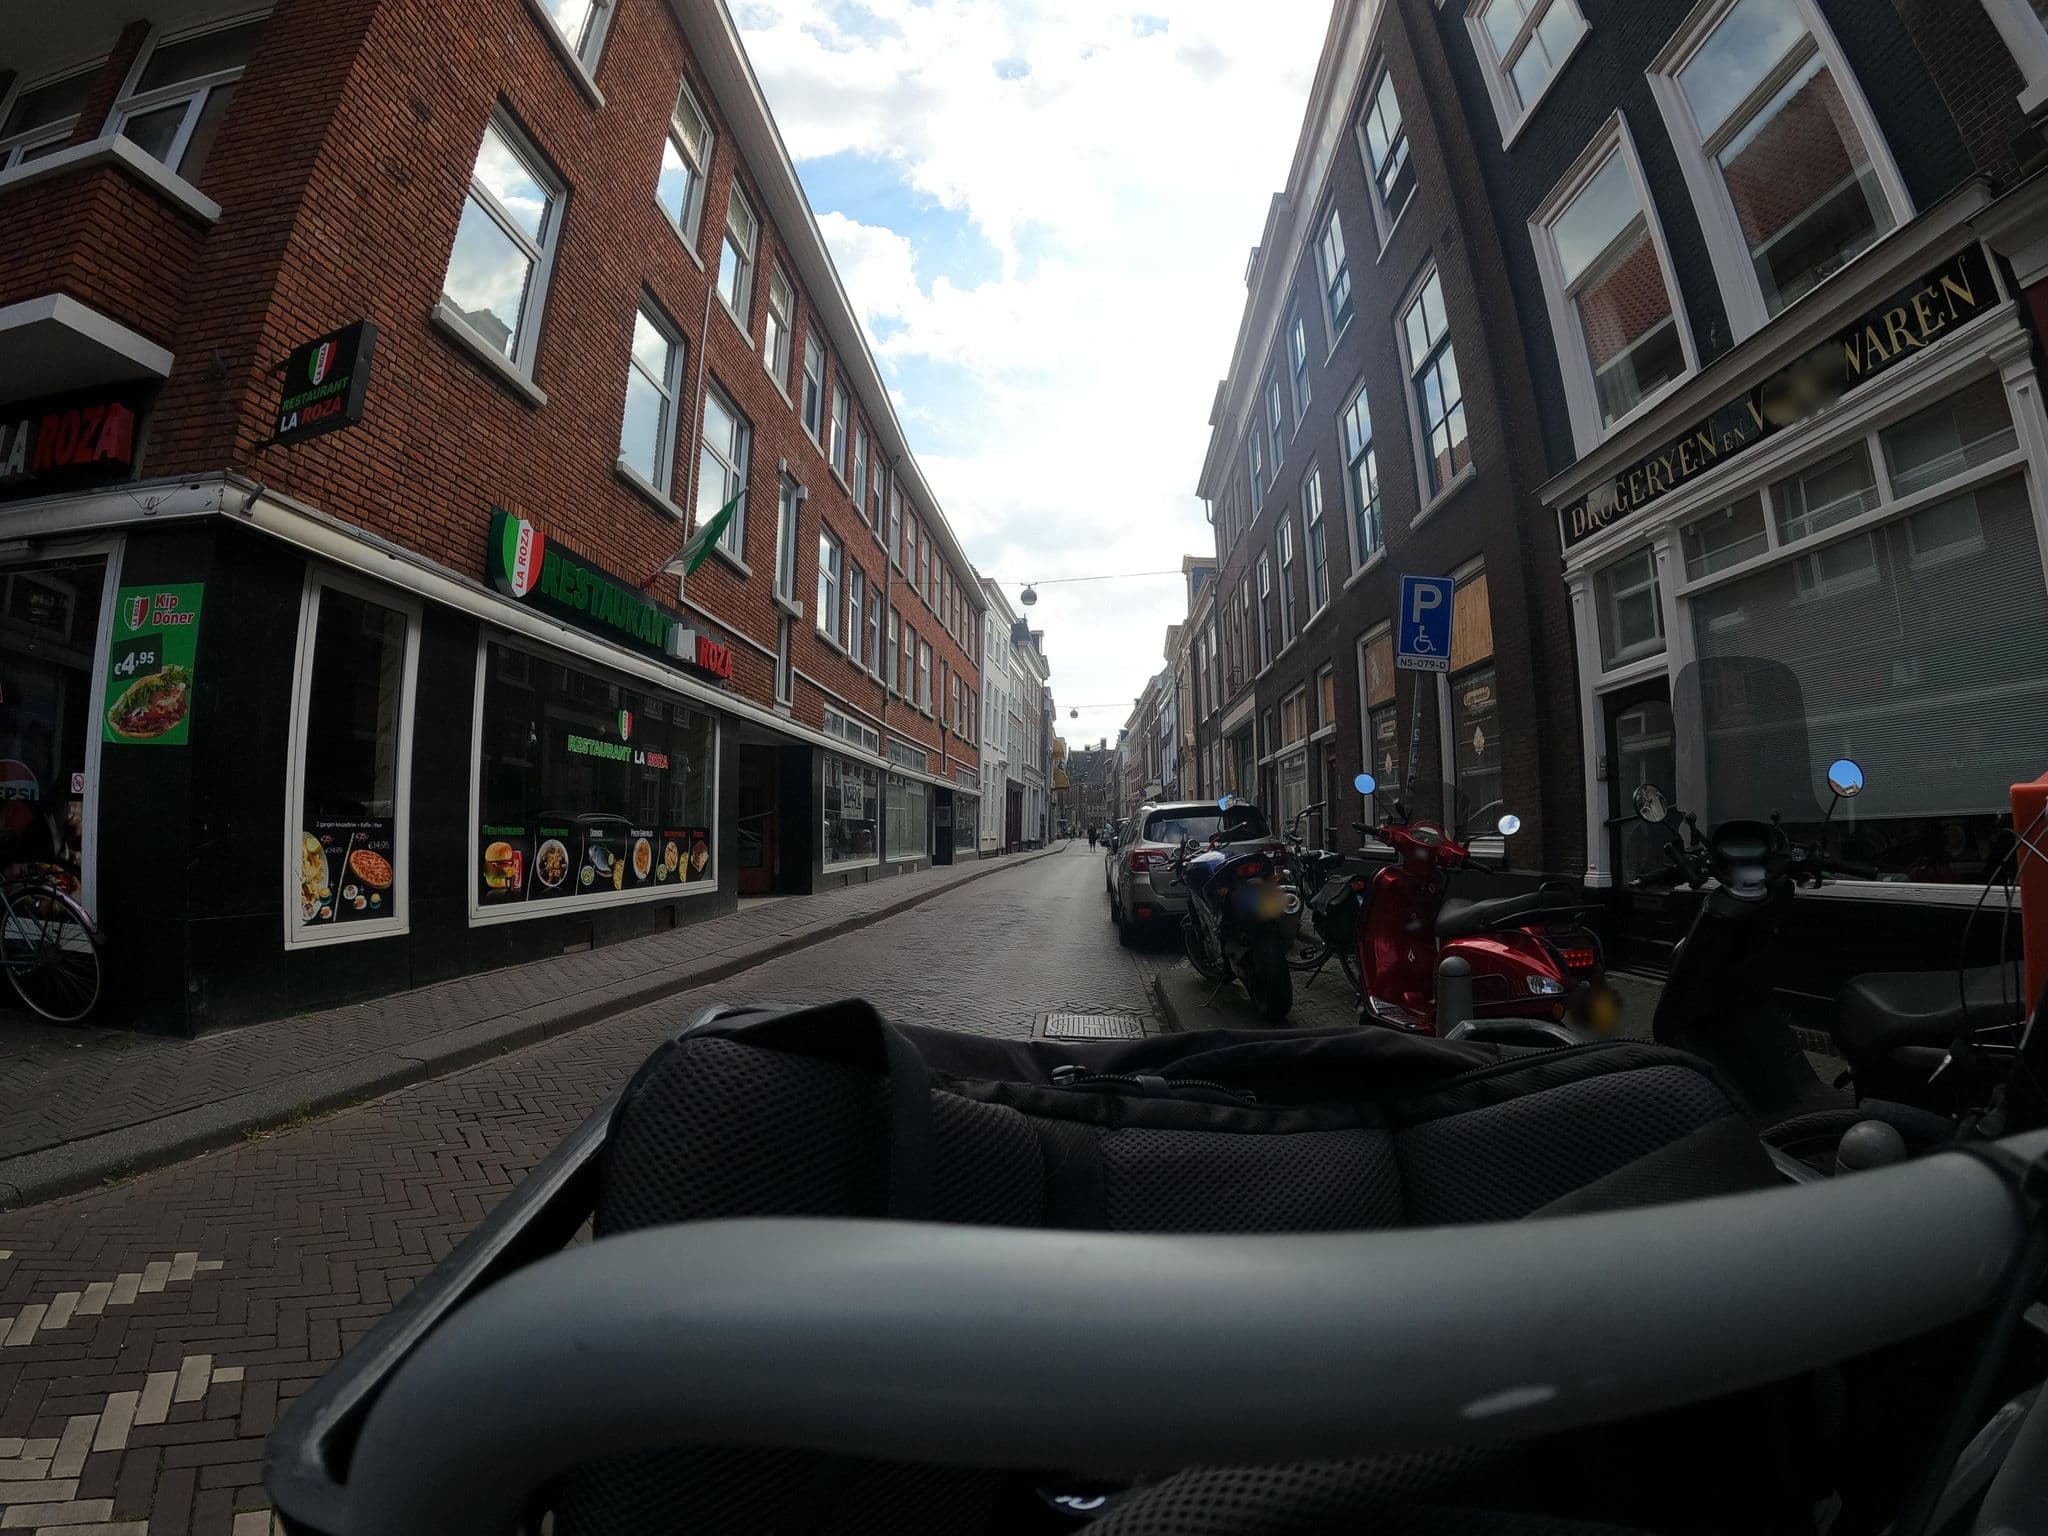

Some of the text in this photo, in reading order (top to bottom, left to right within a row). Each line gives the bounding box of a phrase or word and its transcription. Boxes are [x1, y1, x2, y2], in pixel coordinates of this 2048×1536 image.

[282, 376, 350, 411] RESTAURANT
[280, 395, 343, 433] LA ROZA
[32, 401, 133, 474] ROZA
[1571, 430, 1722, 538] DROGERYEN
[1722, 424, 1746, 453] EN
[515, 527, 531, 590] LA ROZA
[152, 610, 195, 626] Döner
[155, 593, 178, 609] Kip
[541, 547, 732, 680] RESTAURANT LA ROZA
[1412, 583, 1443, 623] P
[114, 651, 155, 675] €4,95
[1400, 658, 1446, 670] NS-079-D
[568, 734, 670, 769] RESTAURANT LA ROZA
